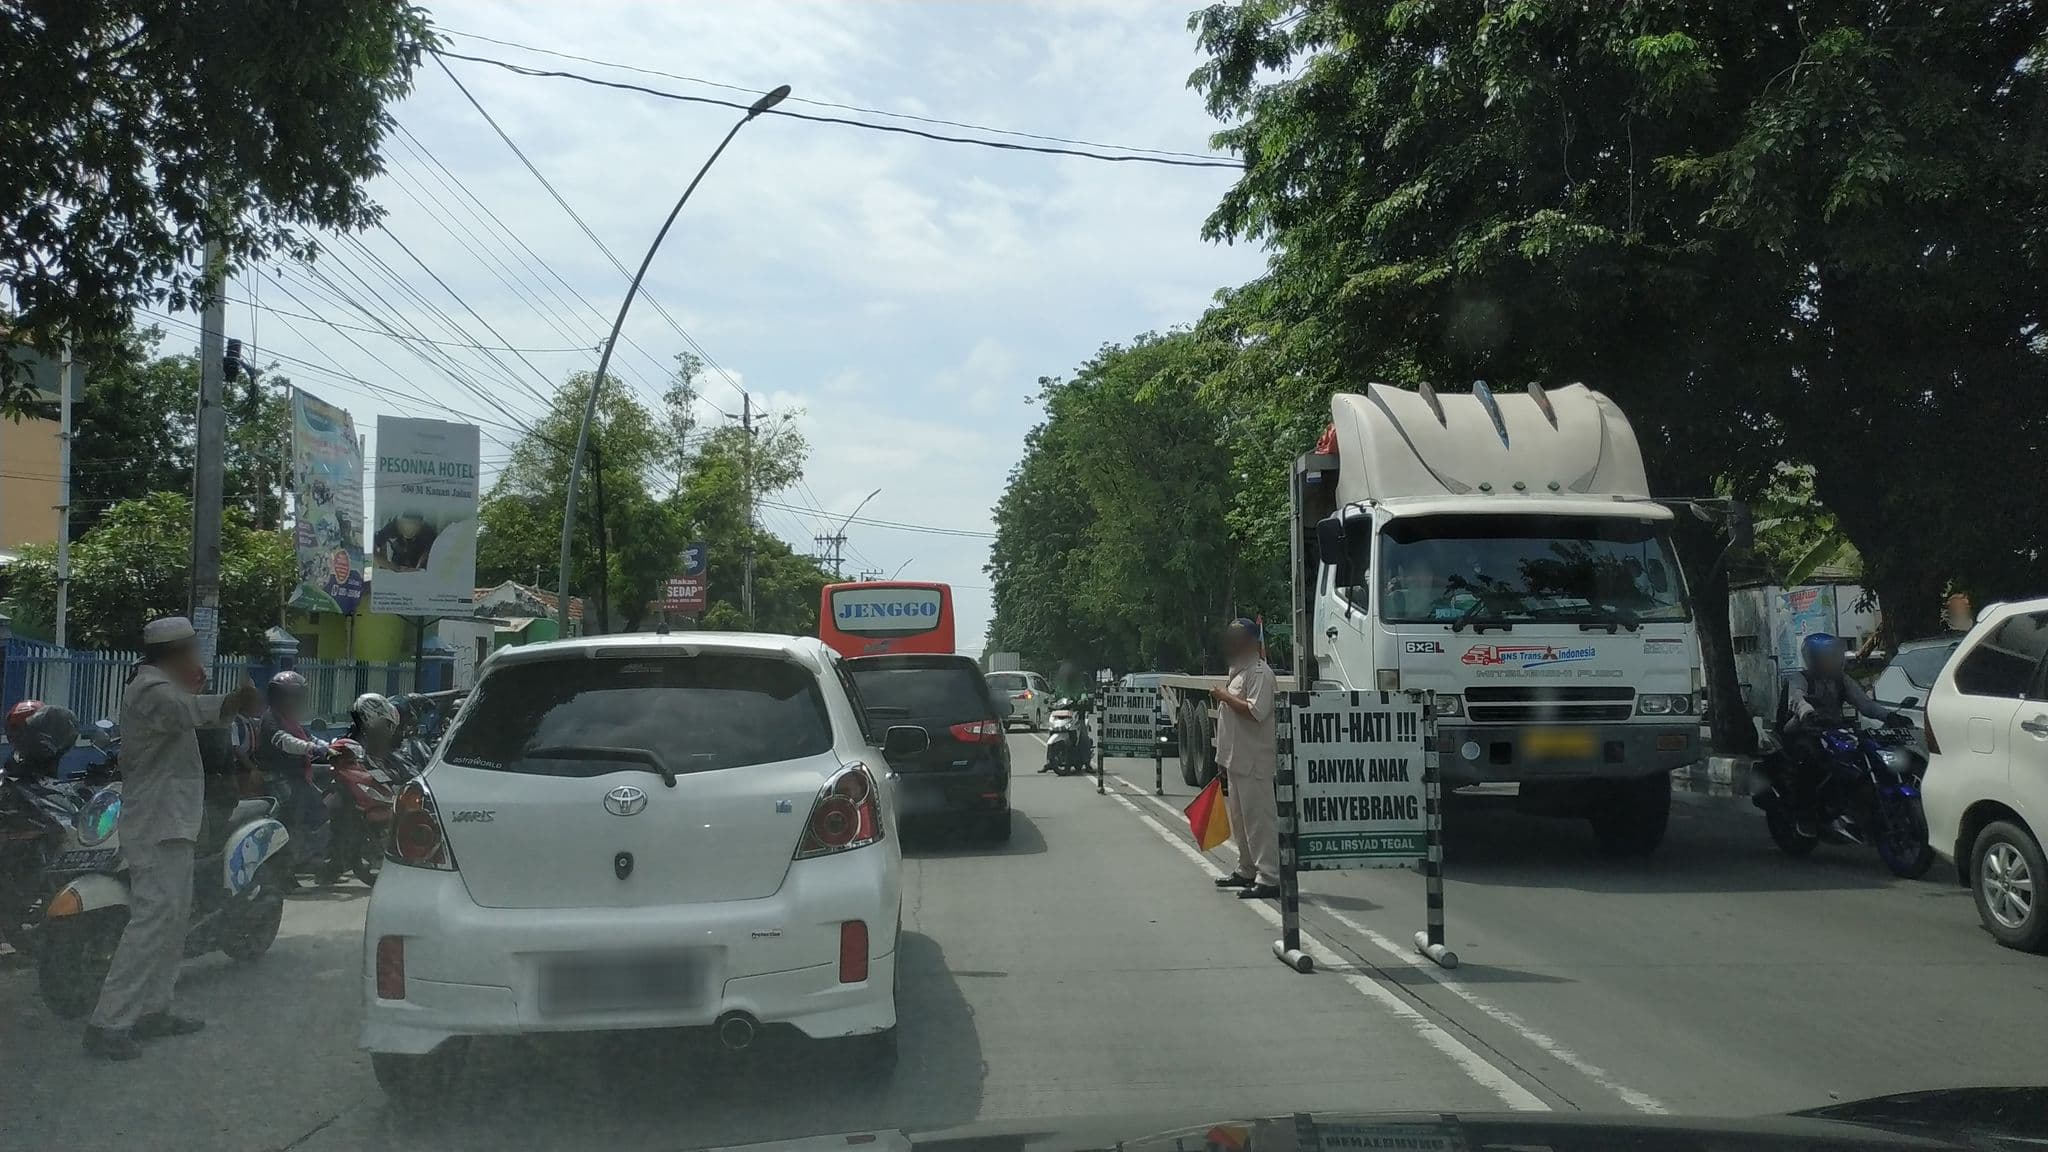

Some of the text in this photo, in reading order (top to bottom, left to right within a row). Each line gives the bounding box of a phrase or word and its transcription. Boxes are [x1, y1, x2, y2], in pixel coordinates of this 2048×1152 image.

[380, 457, 474, 479] PESONNA HOTEL
[426, 487, 450, 497] Kanan
[451, 488, 472, 499] Jalan
[839, 602, 937, 619] JENGGO
[1501, 647, 1596, 660] BNS Trans Indonesia
[1106, 695, 1144, 708] HATI-HATI
[1109, 713, 1150, 725] BANYAK ANAK
[1106, 728, 1153, 740] MENYEBRANG
[1300, 712, 1416, 743] HATI-HATI !!!
[1308, 758, 1409, 783] BANYAK ANAK
[1303, 795, 1418, 823] MENYEBRANG
[1309, 838, 1415, 852] SD AL IRSYAD TEGAL
